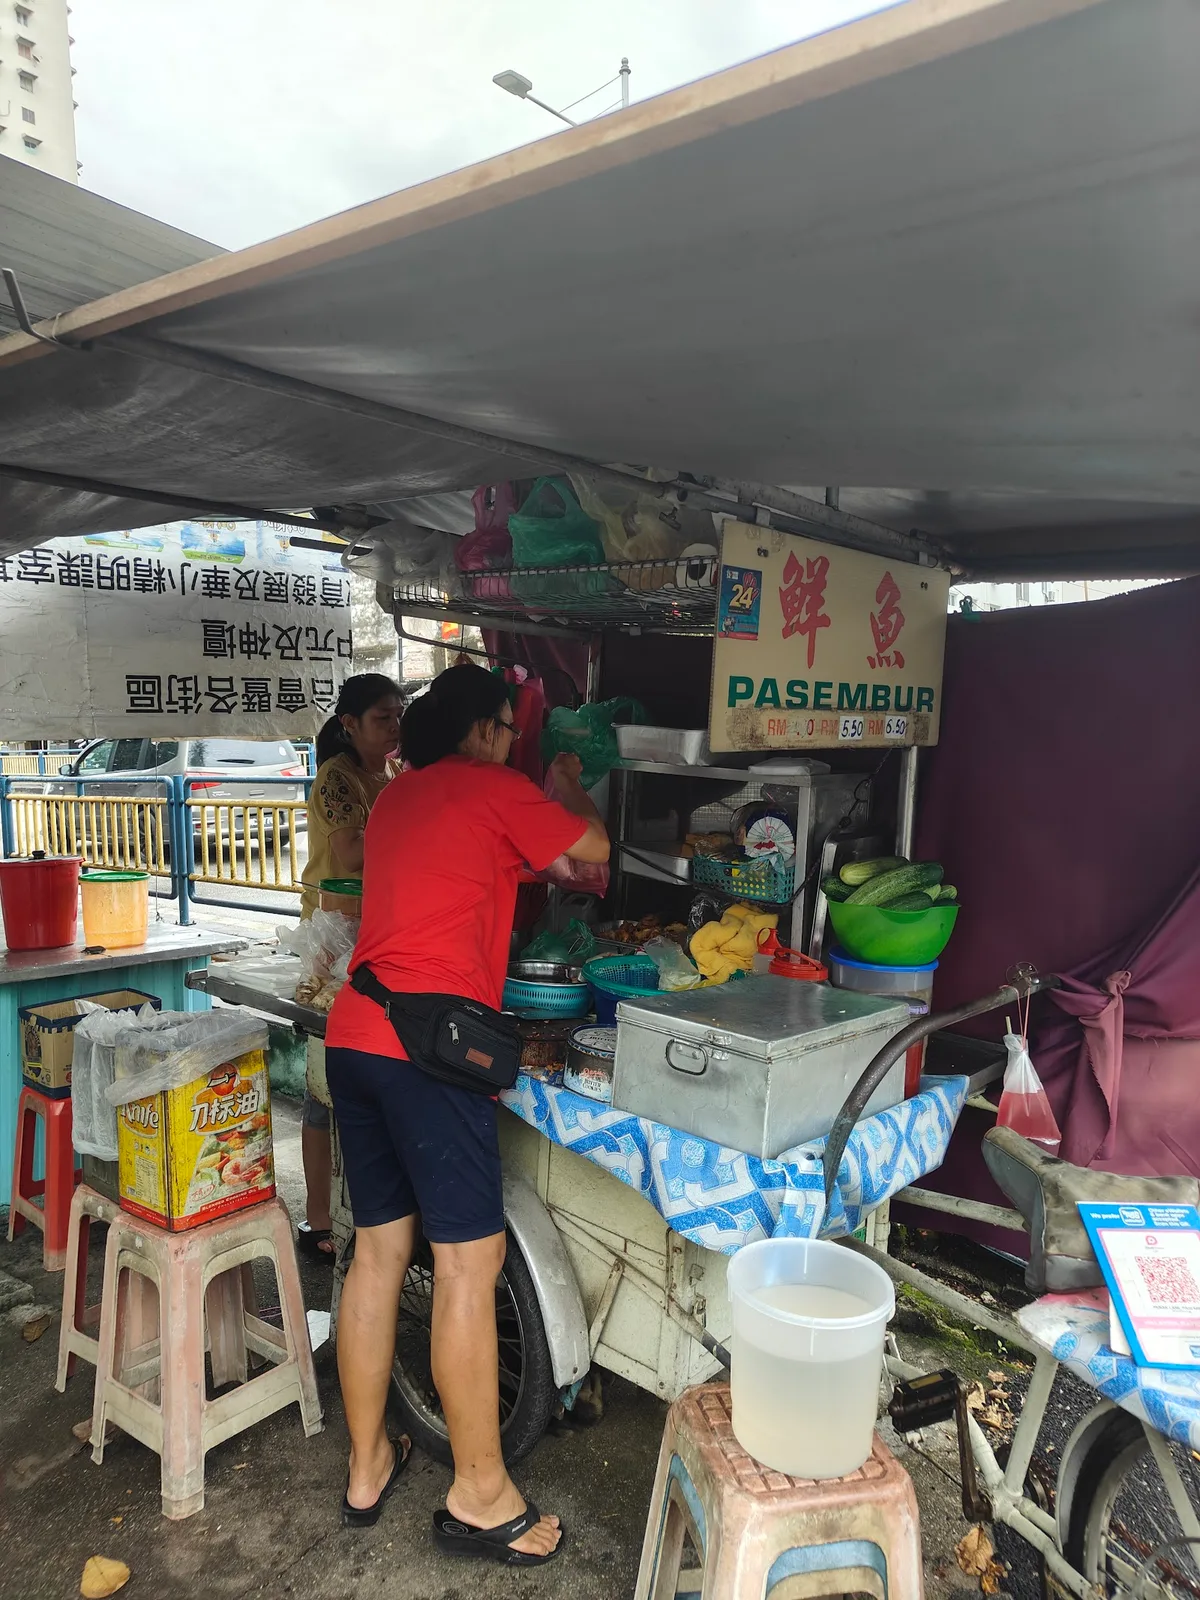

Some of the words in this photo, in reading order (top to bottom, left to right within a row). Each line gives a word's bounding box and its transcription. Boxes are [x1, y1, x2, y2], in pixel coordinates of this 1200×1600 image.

[0, 548, 350, 608] 育發展及華小精明課室
[729, 584, 754, 609] 24
[125, 674, 346, 714] 合會暨各街區
[727, 675, 935, 712] PASEMBUR
[767, 719, 787, 736] RM
[841, 719, 864, 738] 5.50
[868, 719, 883, 735] RM
[885, 719, 907, 735] 6.50
[189, 1089, 260, 1132] 刀标油
